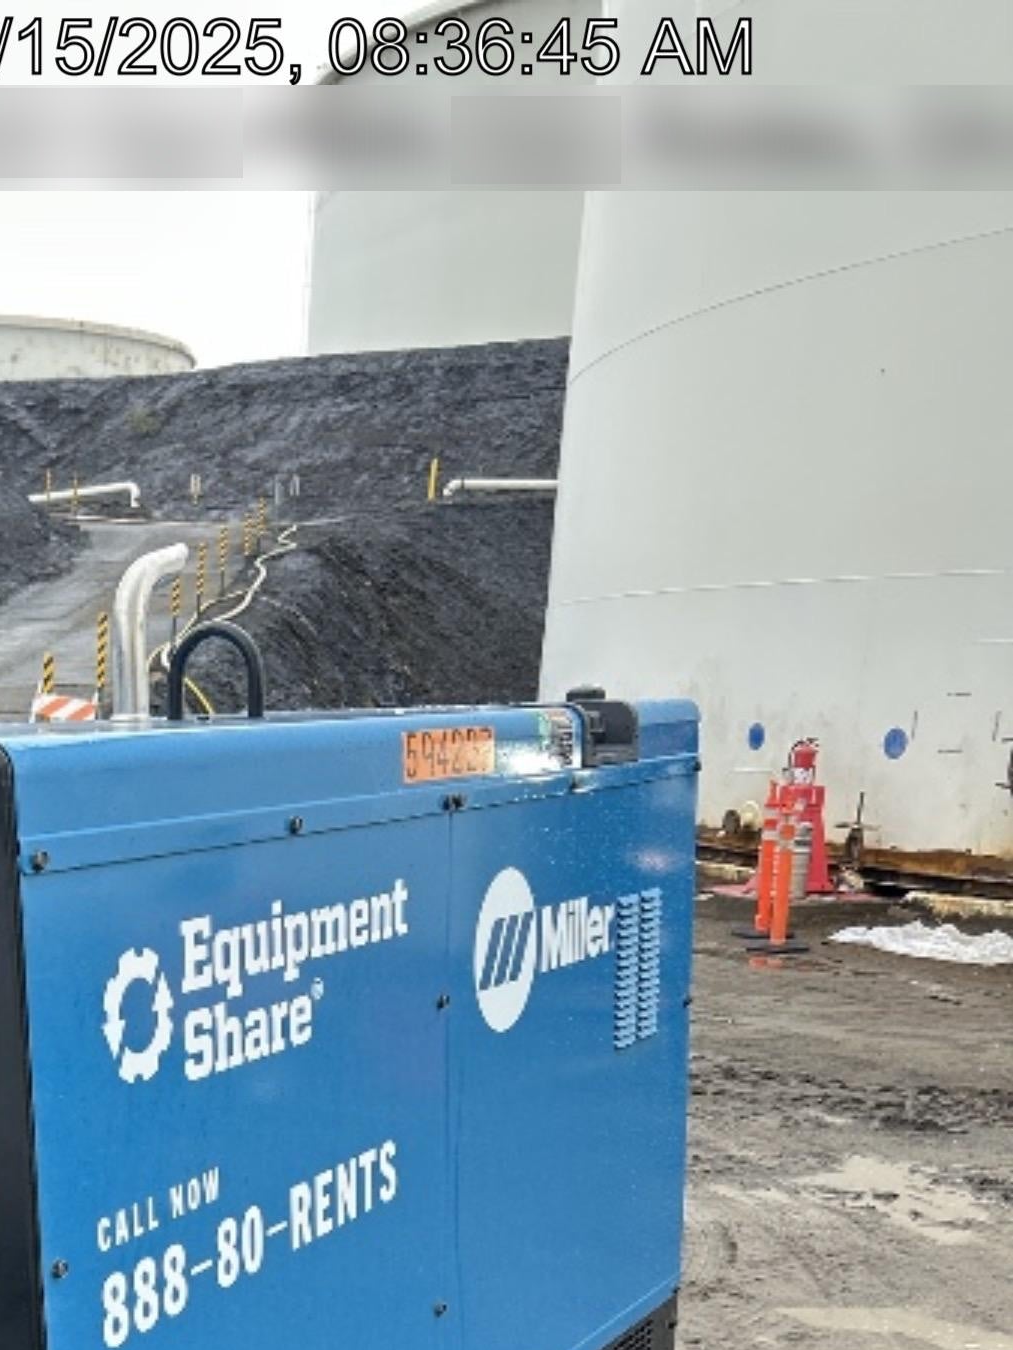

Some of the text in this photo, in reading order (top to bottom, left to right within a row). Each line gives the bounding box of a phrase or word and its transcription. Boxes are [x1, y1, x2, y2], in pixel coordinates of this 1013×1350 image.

[179, 878, 409, 999] Equipment
[540, 896, 616, 973] Miller
[96, 1166, 220, 1251] CALL NOW
[102, 1140, 397, 1348] 888-80-RENTS
